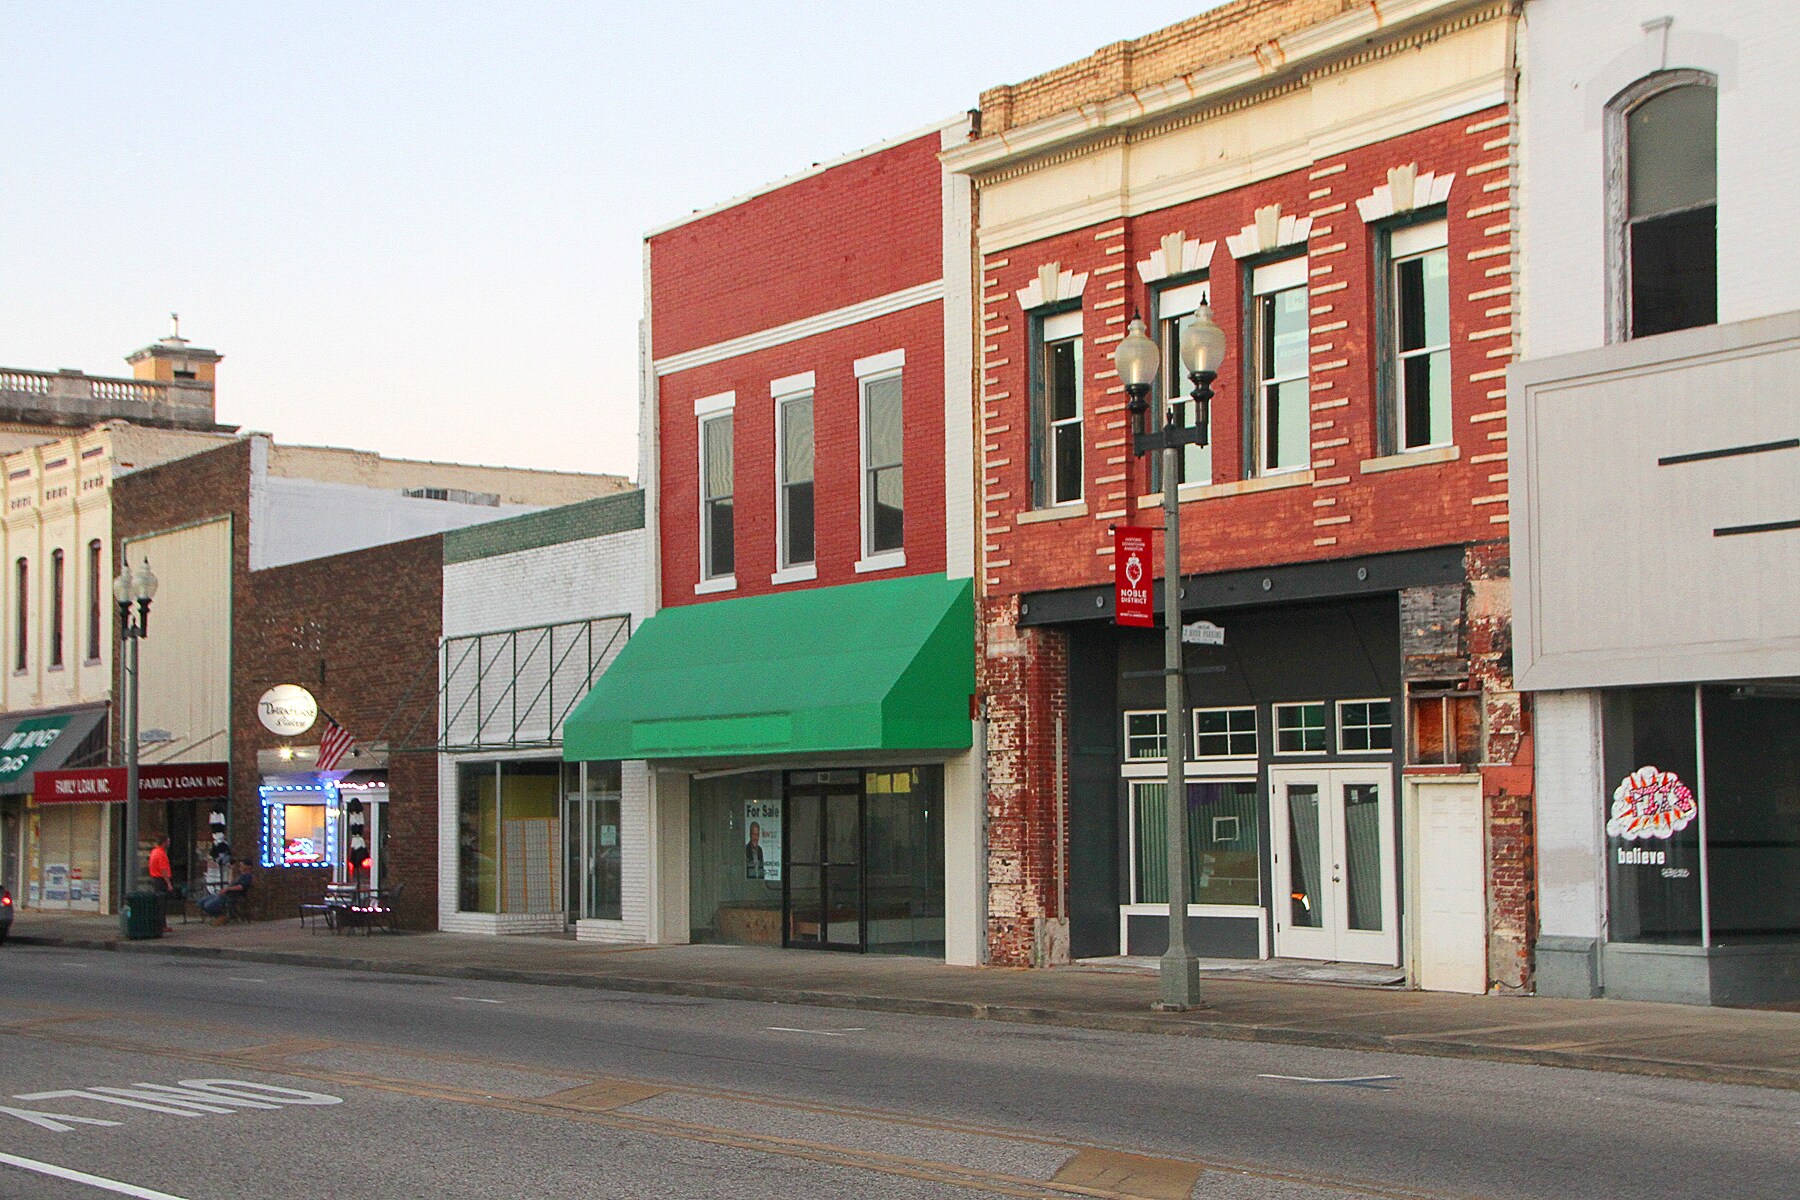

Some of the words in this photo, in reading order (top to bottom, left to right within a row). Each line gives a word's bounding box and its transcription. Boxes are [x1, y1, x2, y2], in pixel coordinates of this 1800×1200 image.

[1120, 588, 1148, 599] NOBLE
[1120, 597, 1147, 605] DISTRICT
[139, 777, 173, 790] FAMILY
[746, 804, 760, 818] For
[762, 804, 780, 818] Sale
[1617, 847, 1666, 865] believe
